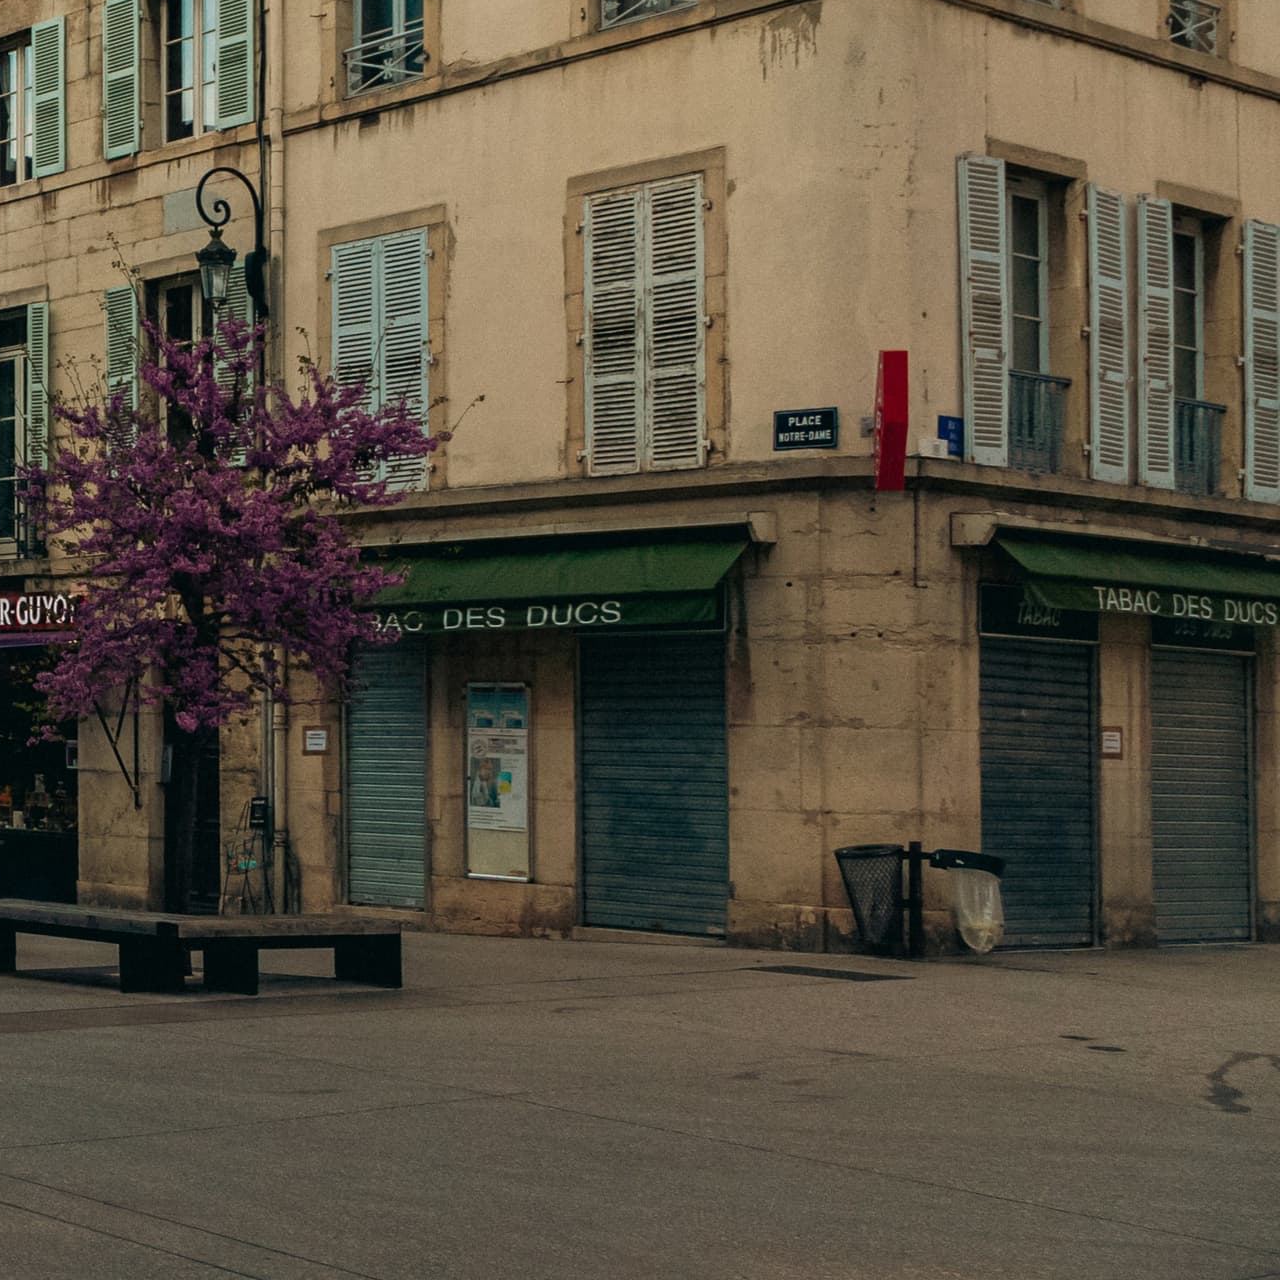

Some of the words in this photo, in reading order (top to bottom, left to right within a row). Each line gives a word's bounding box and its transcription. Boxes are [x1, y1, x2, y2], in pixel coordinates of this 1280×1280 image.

[788, 415, 822, 427] PLACE
[778, 429, 832, 443] NOTRE-DAME
[368, 610, 424, 632] BAC
[442, 606, 506, 630] DES
[526, 600, 622, 627] DUCS
[1093, 586, 1161, 614] TABAC
[1172, 593, 1213, 620] DES
[1224, 599, 1278, 625] DUCS
